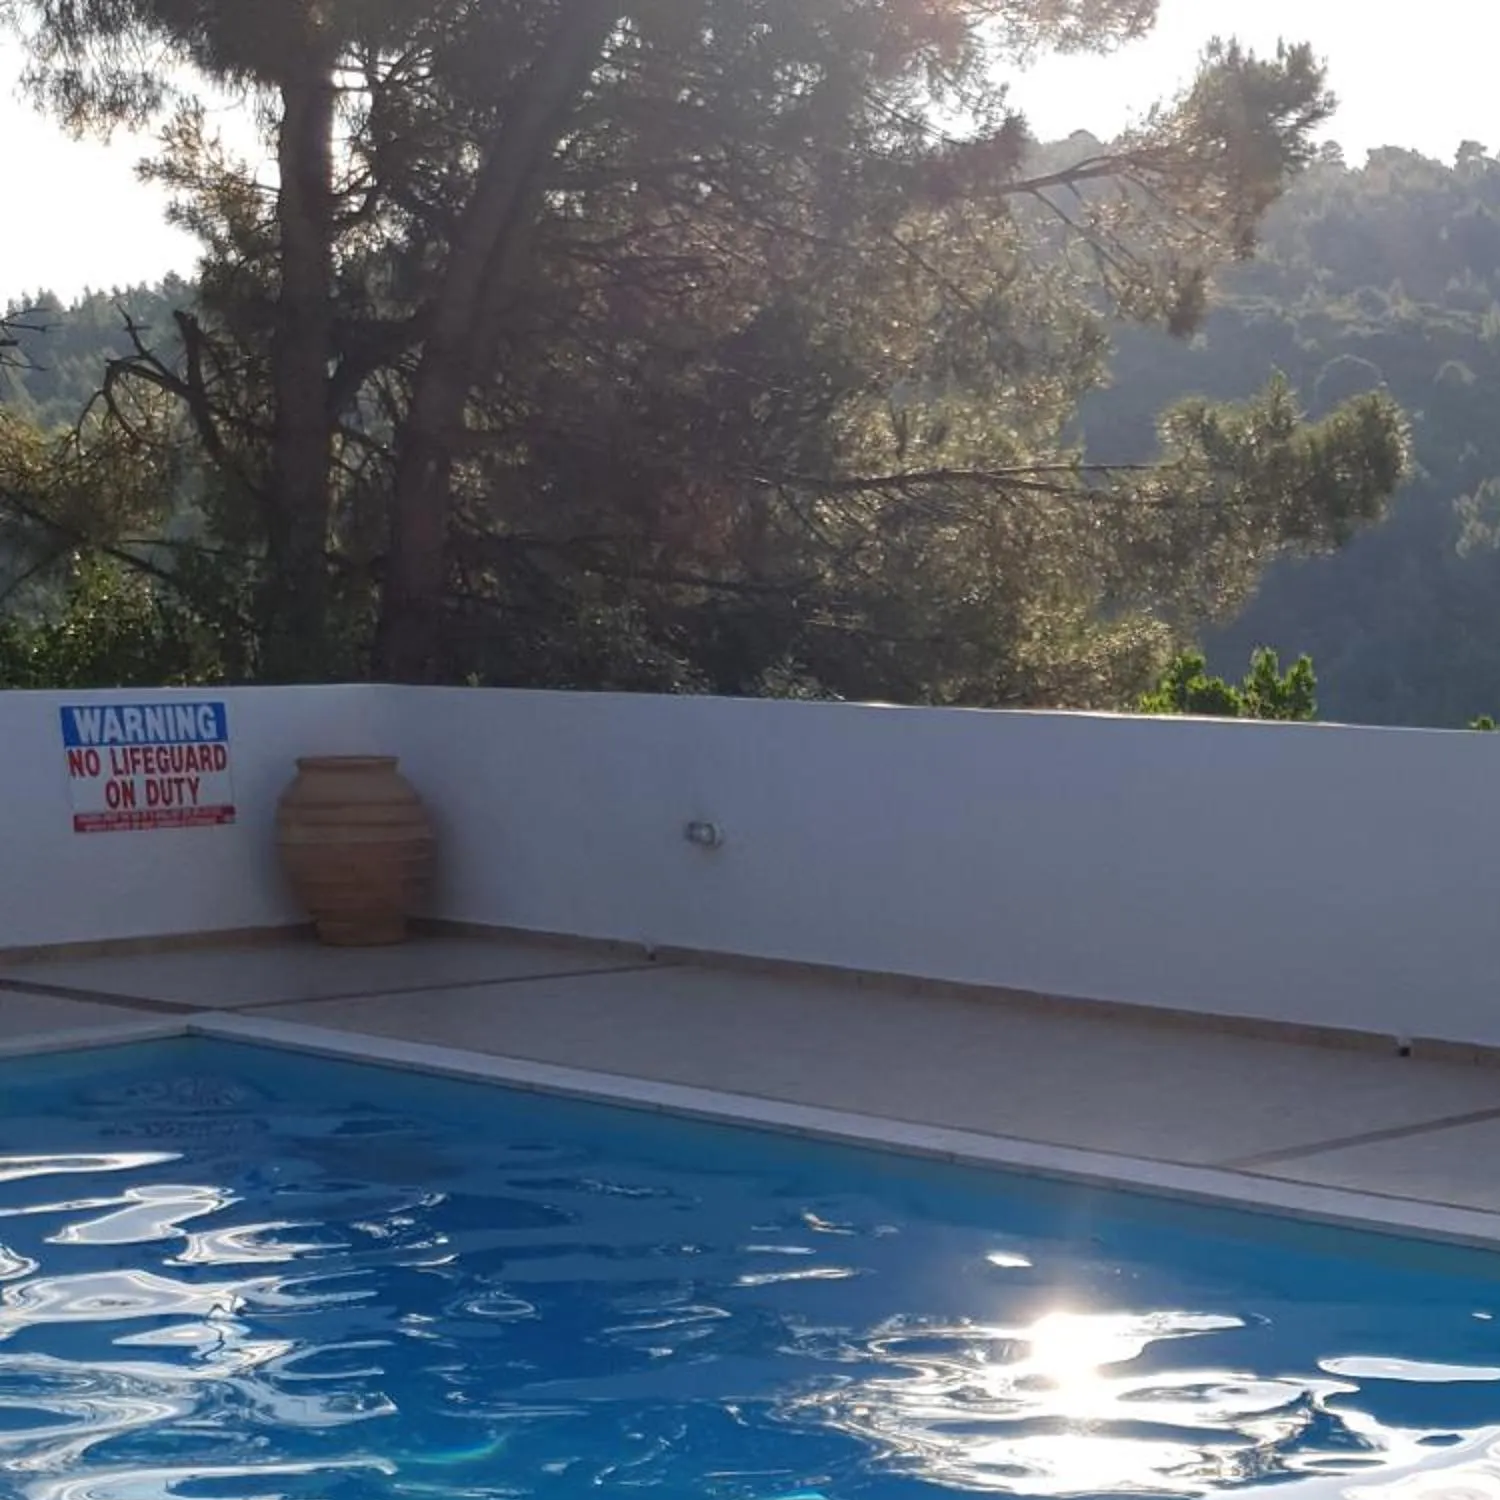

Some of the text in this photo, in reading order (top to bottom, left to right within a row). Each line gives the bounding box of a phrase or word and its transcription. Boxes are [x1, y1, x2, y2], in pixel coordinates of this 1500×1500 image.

[73, 706, 217, 743] WARNING
[68, 744, 227, 777] NO LIFEGUARD
[105, 777, 200, 808] ON DUTY
